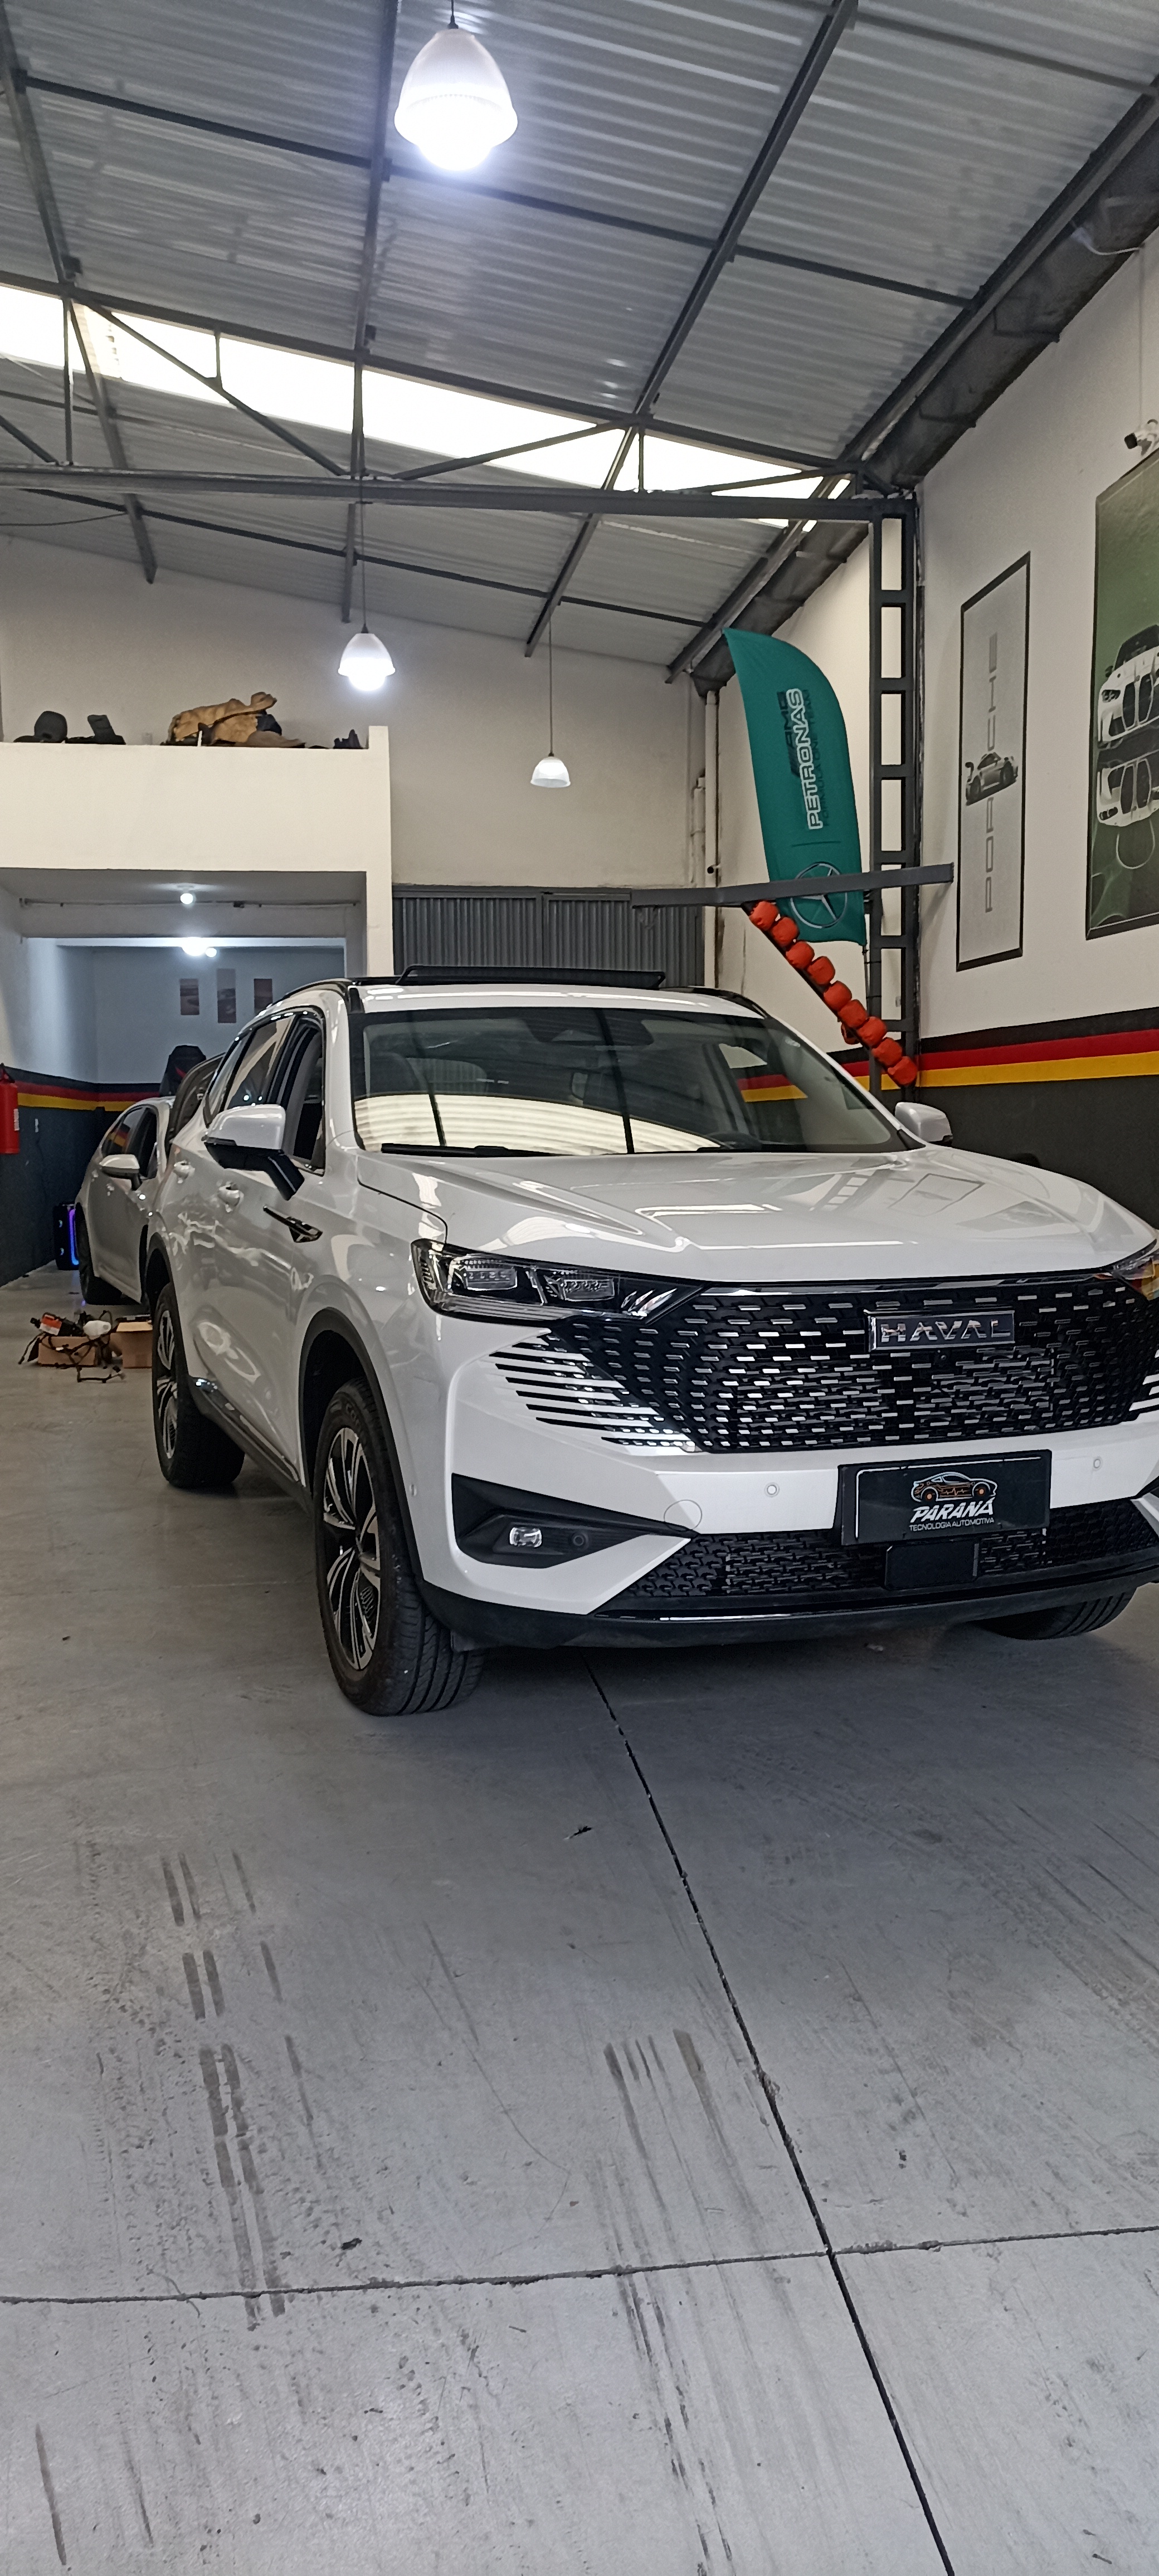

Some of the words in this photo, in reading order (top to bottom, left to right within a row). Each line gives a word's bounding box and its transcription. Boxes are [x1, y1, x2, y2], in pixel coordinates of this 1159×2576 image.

[786, 688, 823, 830] PETRONAS
[985, 632, 998, 913] PORCHE
[880, 1320, 1011, 1343] HAVAL
[910, 1496, 996, 1524] PARANÁ
[909, 1520, 951, 1532] TECNOLOGIA
[952, 1517, 995, 1527] AUTOMOTIVA
